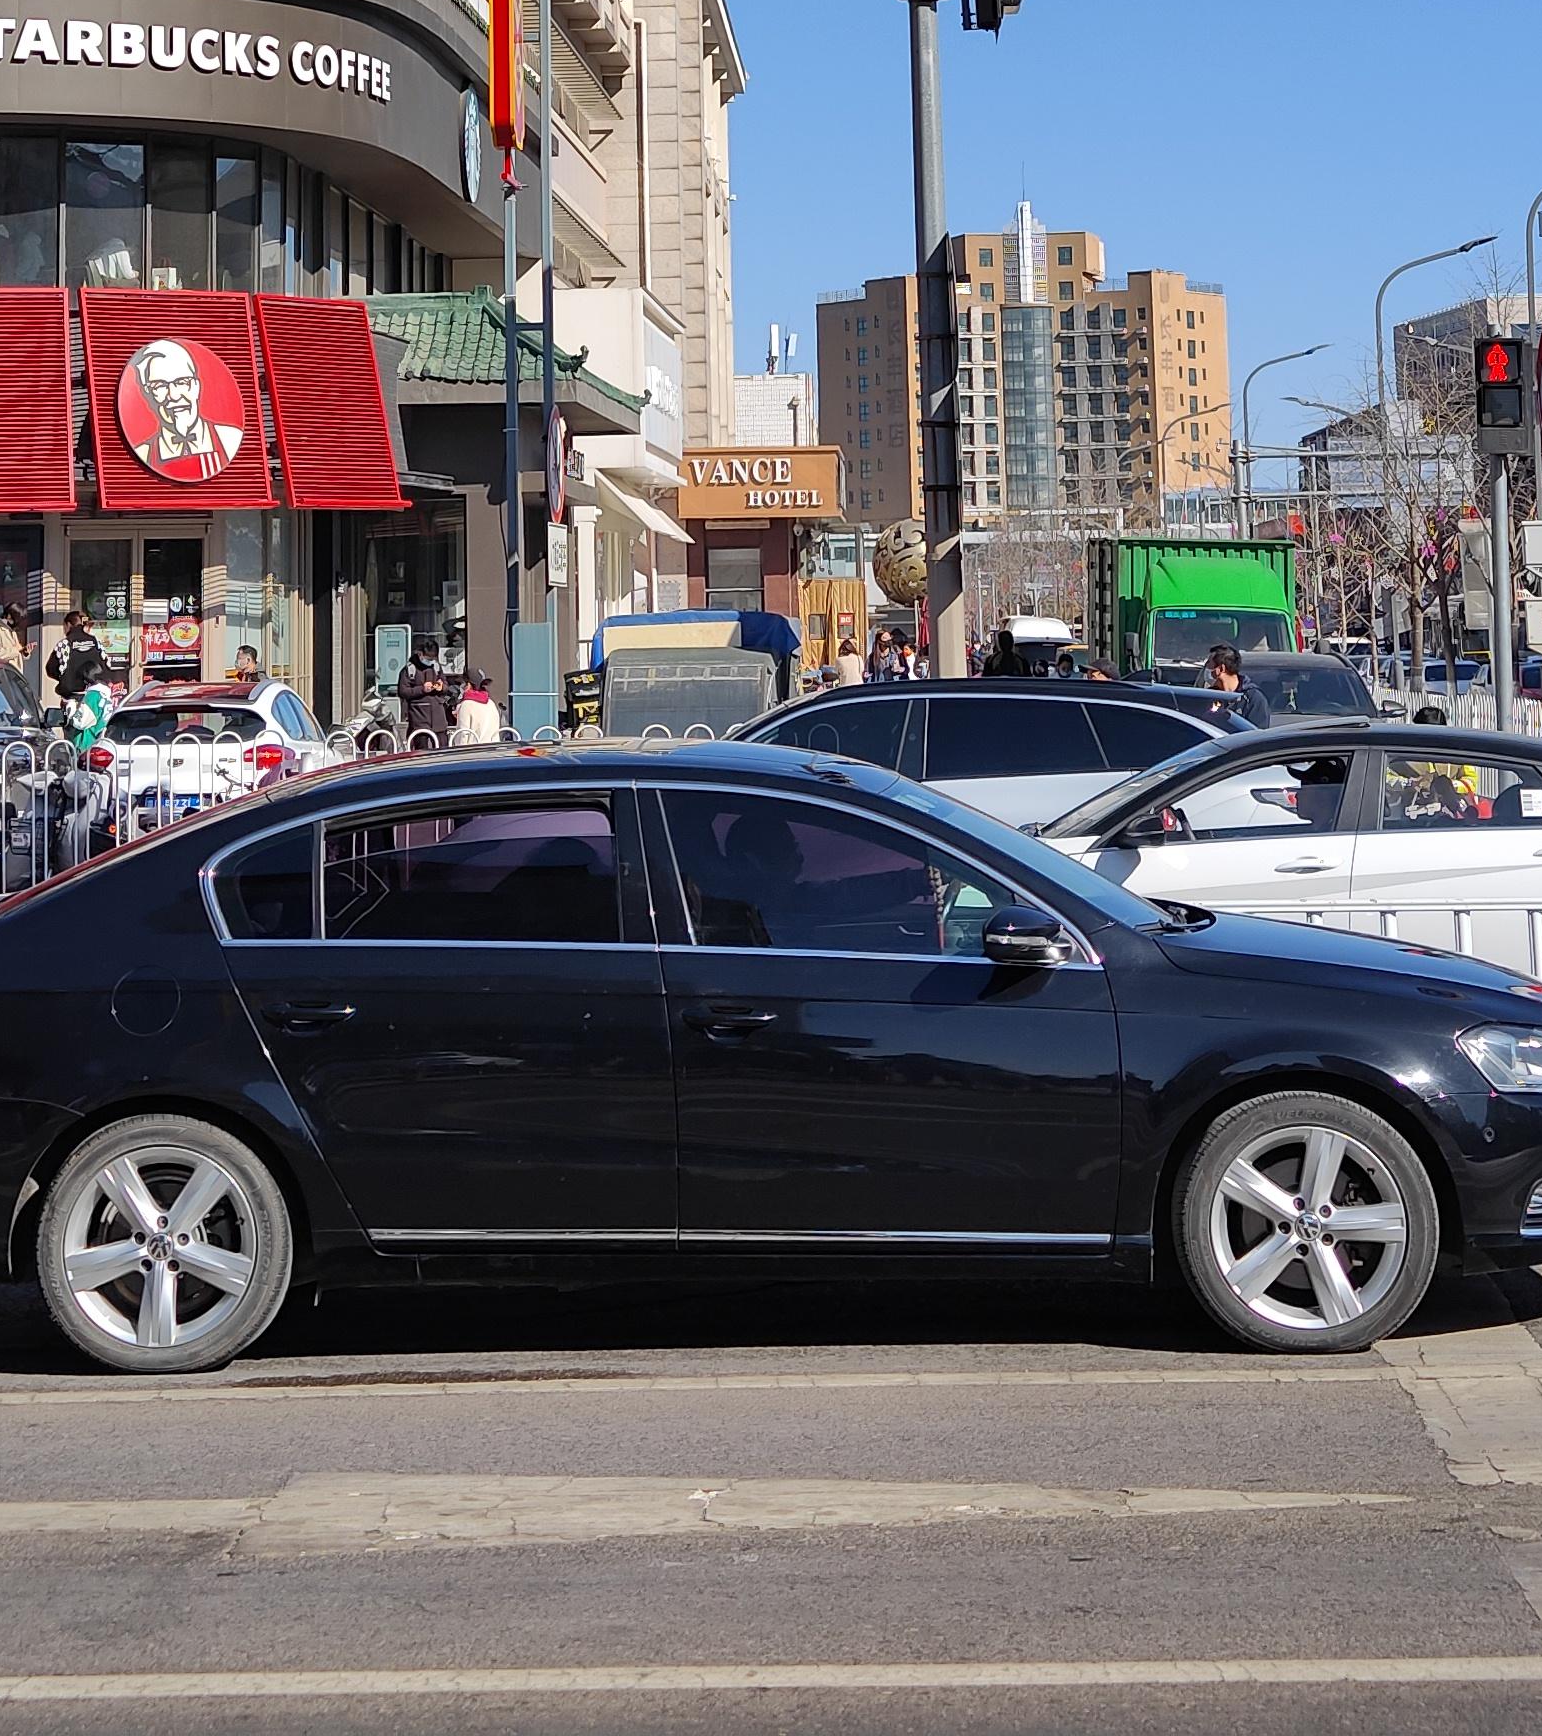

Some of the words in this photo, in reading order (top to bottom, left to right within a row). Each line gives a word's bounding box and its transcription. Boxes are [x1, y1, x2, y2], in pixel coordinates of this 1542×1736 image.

[290, 40, 393, 103] COFFEE
[690, 456, 793, 486] VANCE
[747, 489, 824, 508] HOTEL
